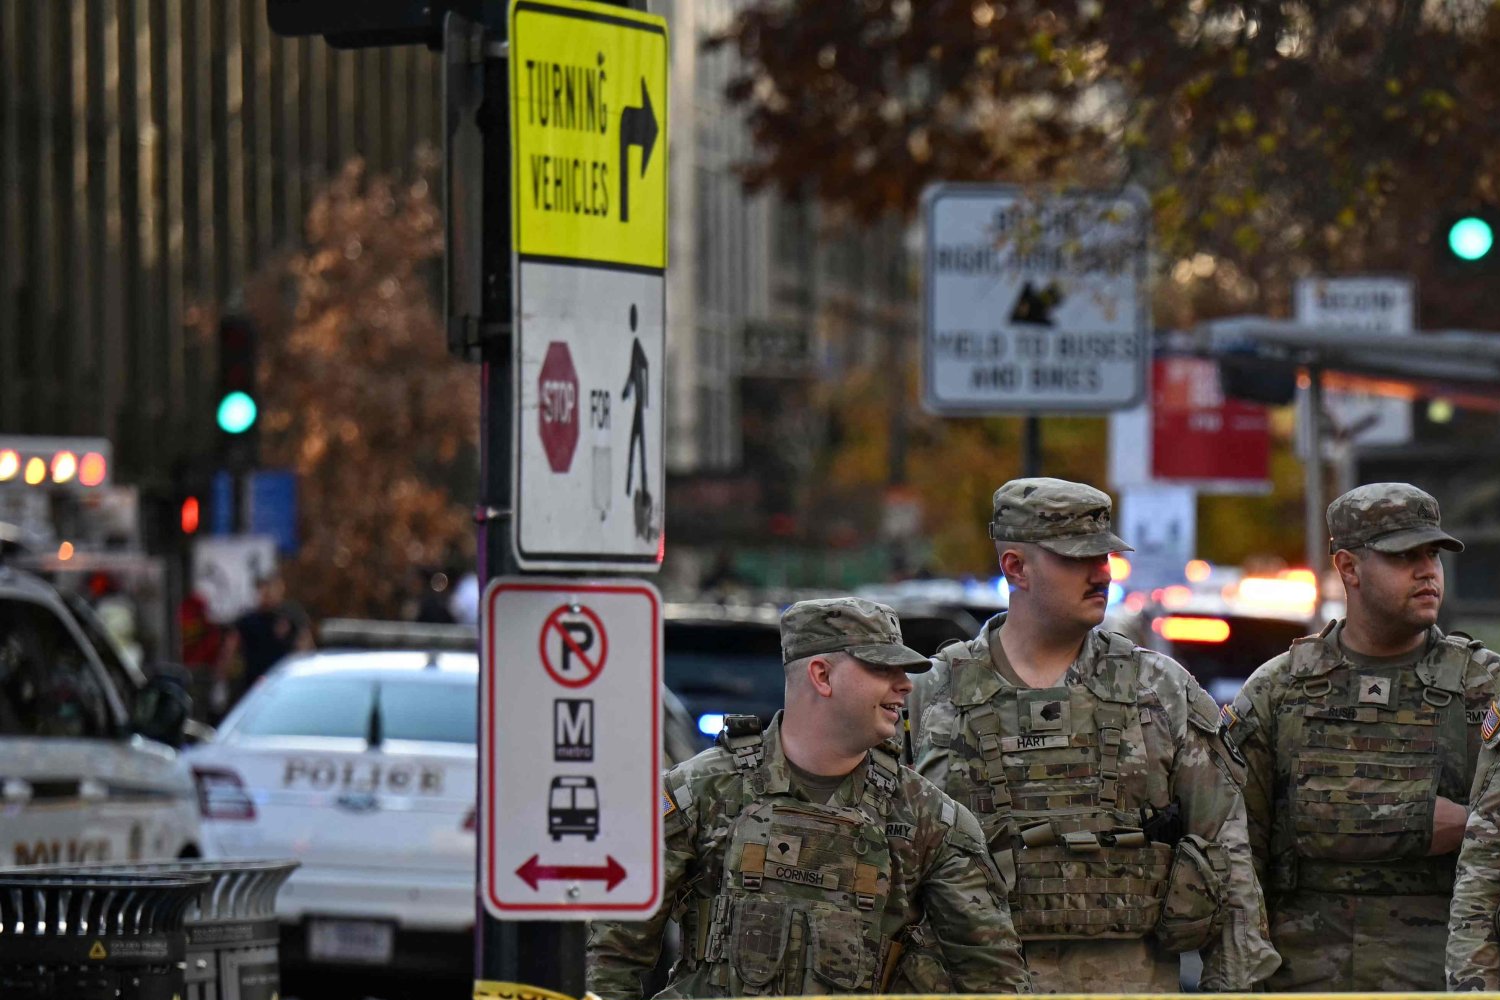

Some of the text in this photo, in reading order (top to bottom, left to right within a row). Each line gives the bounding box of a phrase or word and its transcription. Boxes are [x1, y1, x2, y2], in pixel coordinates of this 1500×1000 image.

[526, 60, 607, 135] TURNING
[531, 154, 608, 217] VEHICLES
[543, 381, 611, 430] STOP FOR
[1329, 707, 1356, 719] RUSH
[1466, 711, 1489, 722] RMY
[556, 701, 591, 746] M
[1017, 735, 1046, 749] HART
[556, 747, 591, 758] metro
[282, 757, 447, 793] POLICE
[885, 823, 912, 838] RMY
[776, 866, 824, 885] CORNISH
